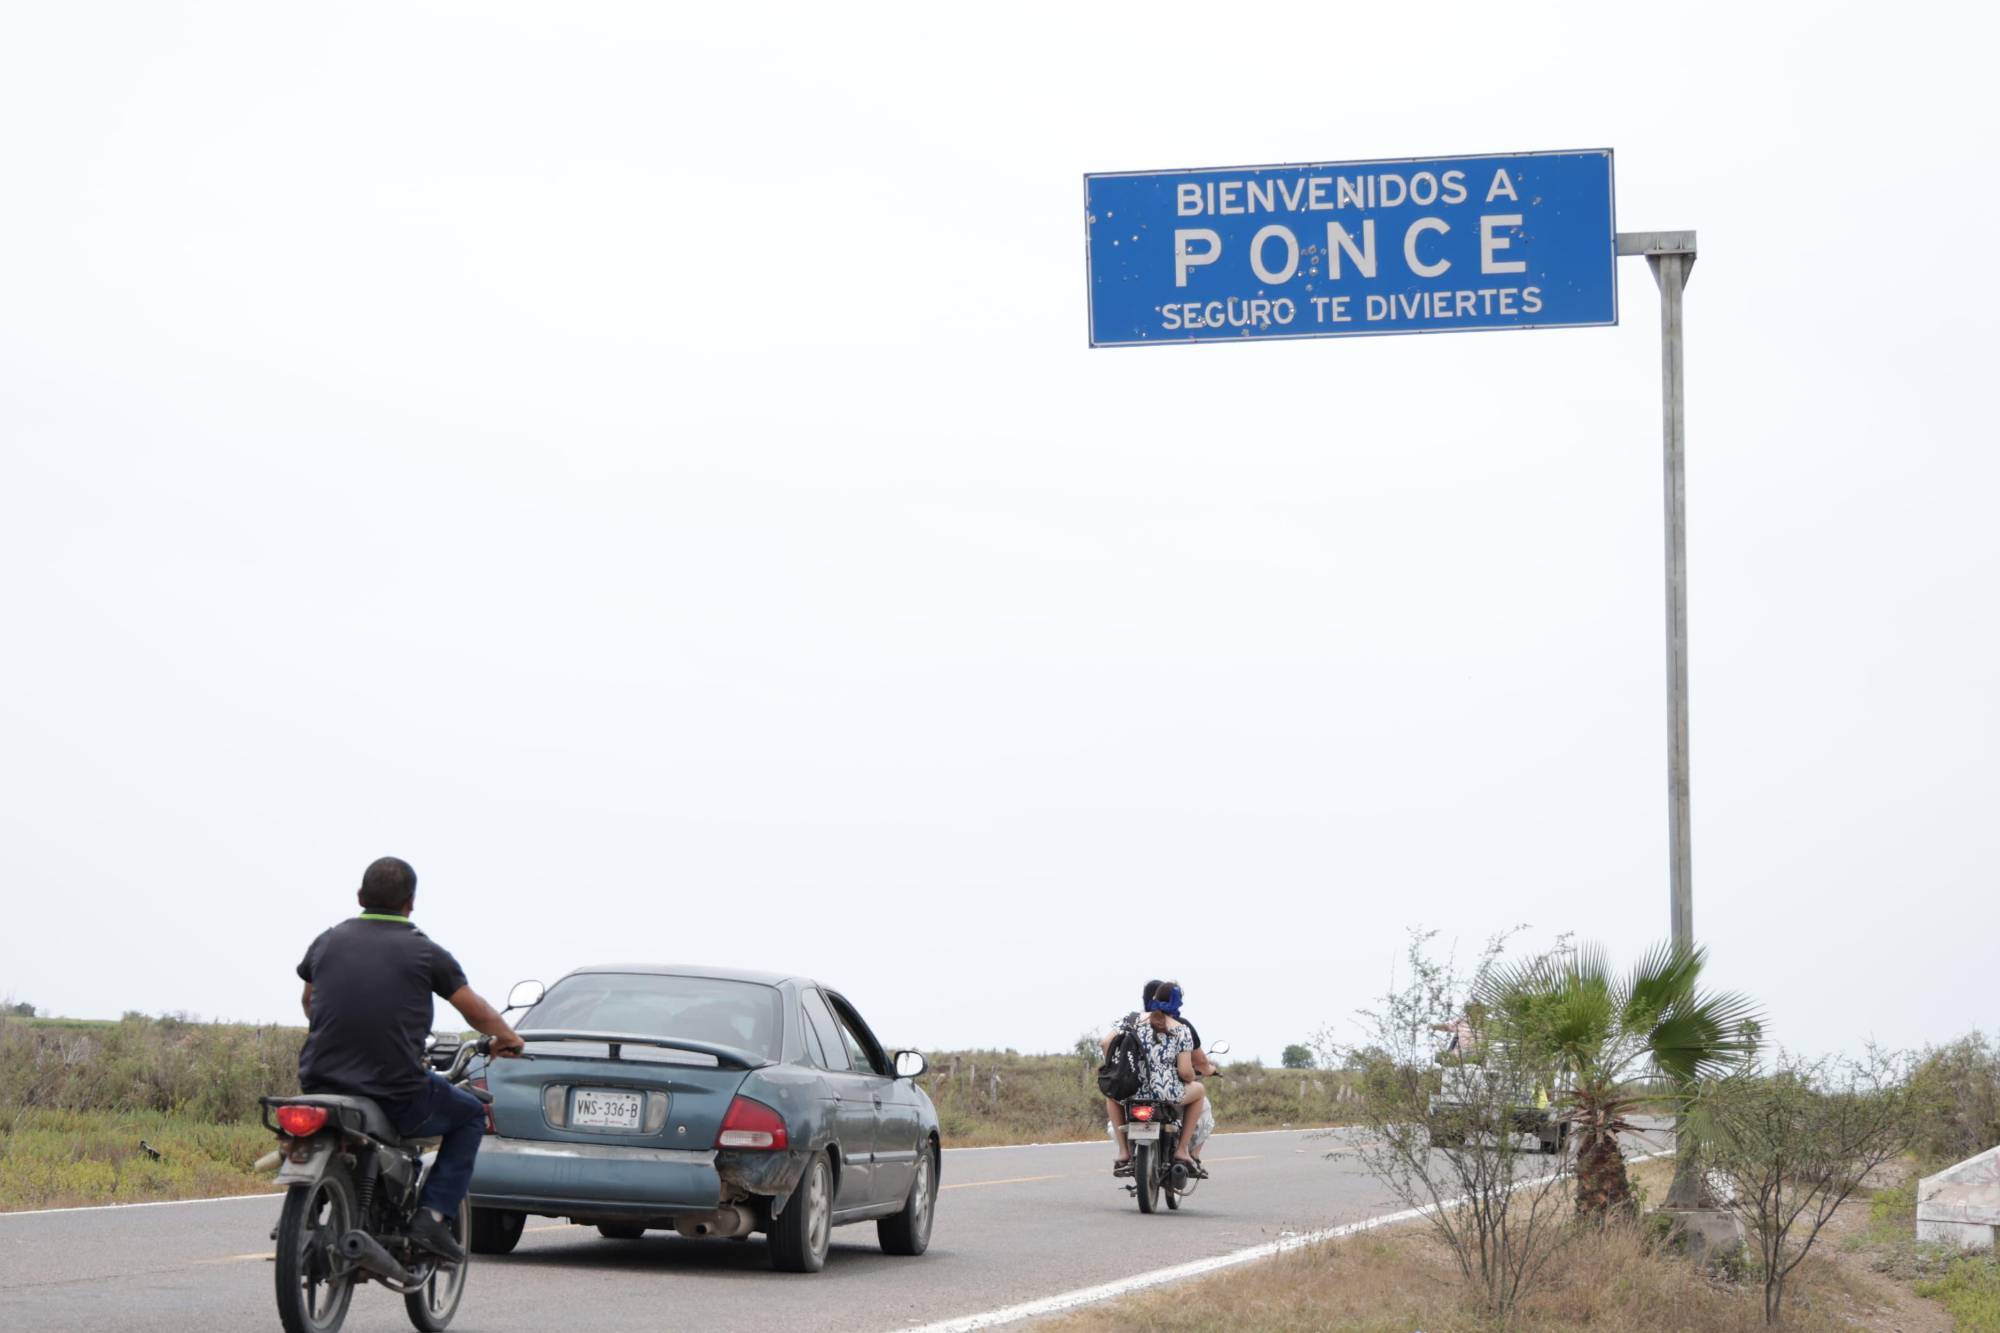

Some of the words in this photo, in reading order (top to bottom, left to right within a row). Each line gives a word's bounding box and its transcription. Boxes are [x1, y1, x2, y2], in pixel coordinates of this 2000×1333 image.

[1177, 170, 1467, 215] BIENVENIDOS
[1486, 169, 1518, 202] A
[1175, 215, 1526, 287] PONCE
[1161, 297, 1295, 330] SEGURO
[1314, 297, 1351, 323] TE
[1366, 287, 1543, 321] DIVIERTES
[578, 1100, 638, 1118] VNS-336-B
